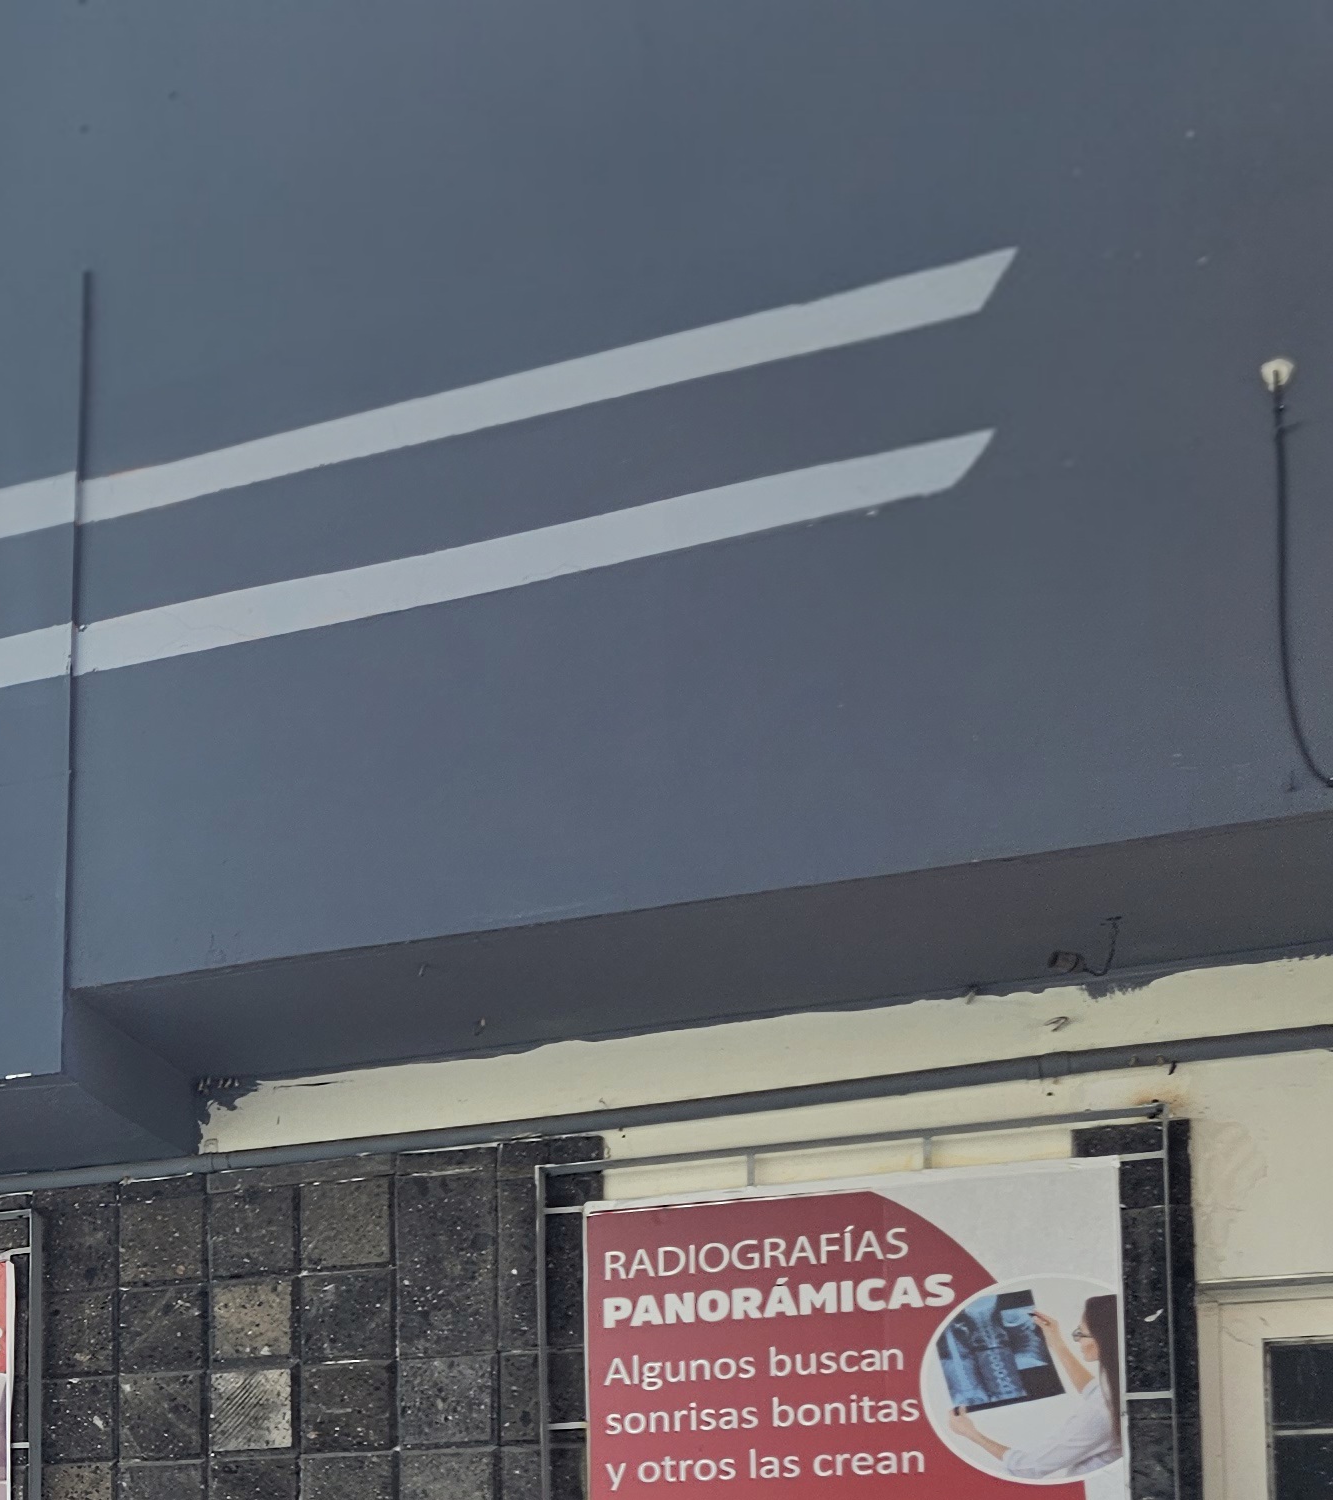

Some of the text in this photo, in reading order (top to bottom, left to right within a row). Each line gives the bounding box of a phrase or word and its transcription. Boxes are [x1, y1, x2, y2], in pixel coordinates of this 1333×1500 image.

[603, 1224, 910, 1281] RADIOGRAFÍAS
[602, 1273, 956, 1329] PANORÁMICAS
[604, 1346, 905, 1391] Algunos buscan
[605, 1395, 921, 1435] sonrisas bonitas
[605, 1448, 925, 1491] y otros las crean
